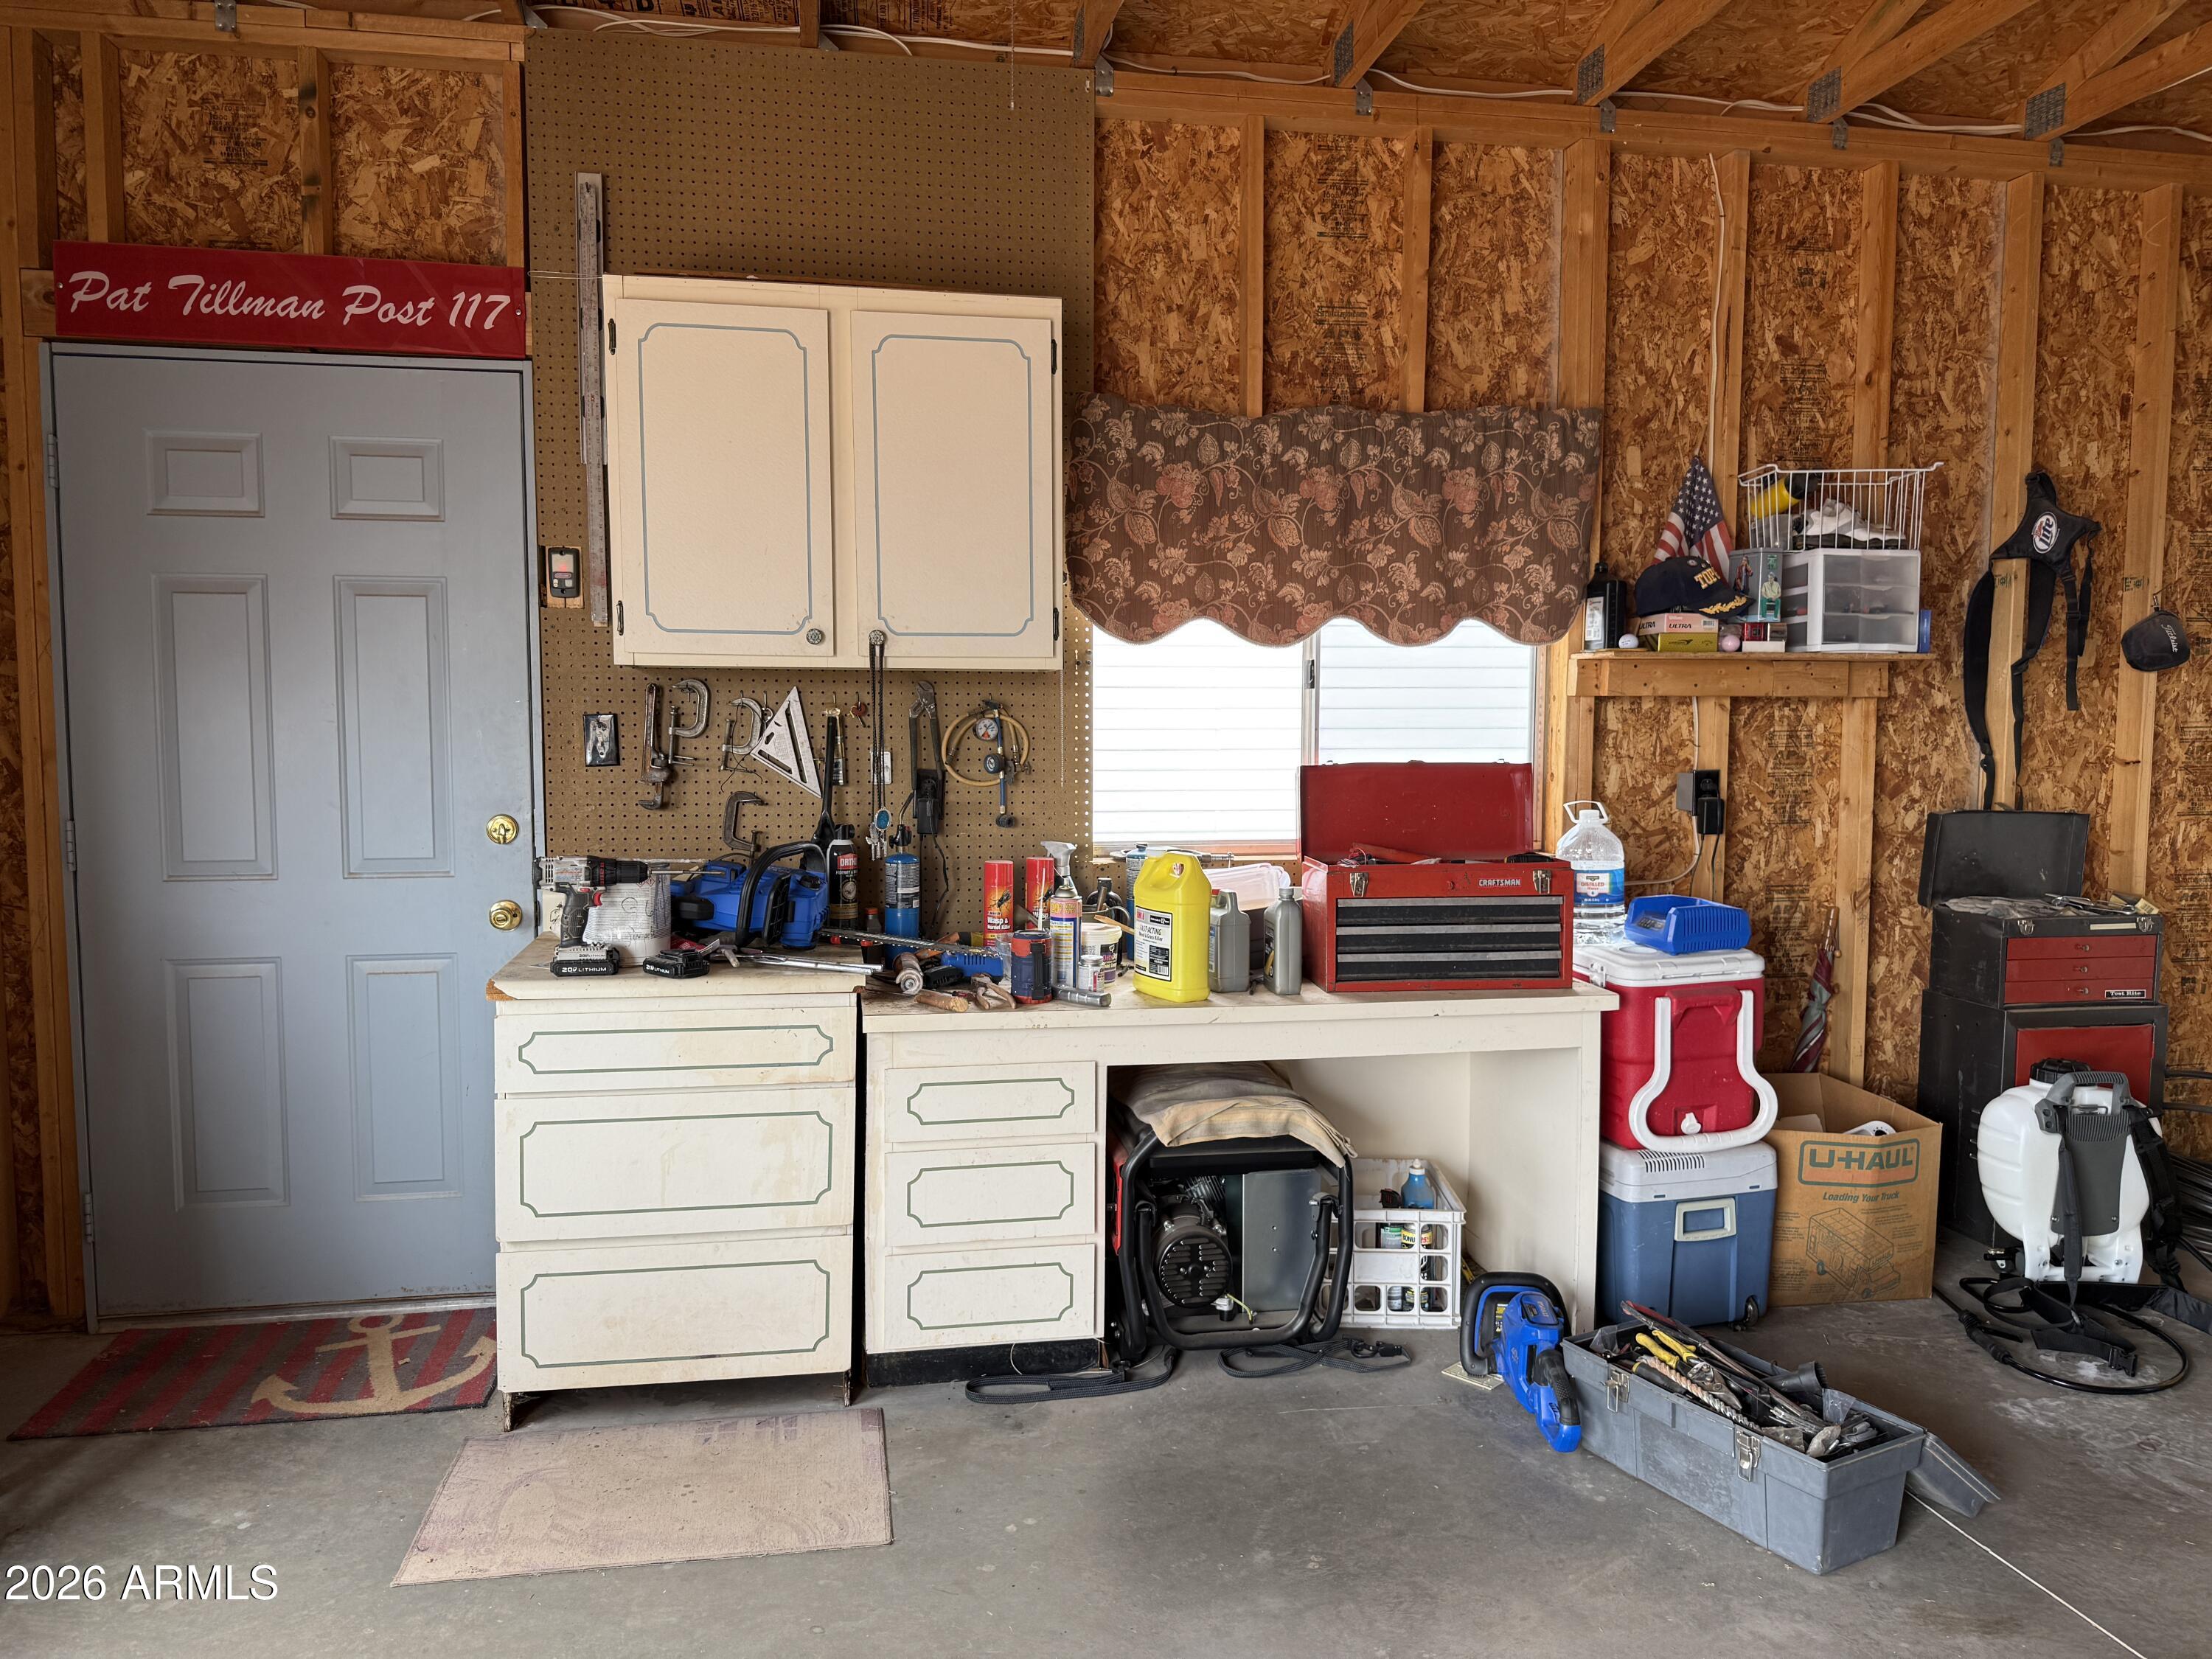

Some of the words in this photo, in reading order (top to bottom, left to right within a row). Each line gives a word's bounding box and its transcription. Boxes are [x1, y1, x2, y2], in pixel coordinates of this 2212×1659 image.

[69, 271, 153, 313] Pat
[168, 274, 326, 320] Tillman
[342, 285, 437, 326] Post
[449, 291, 511, 330] 117
[2039, 518, 2053, 546] Lite
[1639, 621, 1656, 630] ULTRA
[2161, 624, 2178, 653] Titleist
[1809, 1147, 1913, 1171] U-HAUL
[1823, 1192, 1859, 1203] Loading
[1861, 1192, 1880, 1202] Your
[1880, 1191, 1900, 1201] Truck
[1402, 1234, 1416, 1243] BONU
